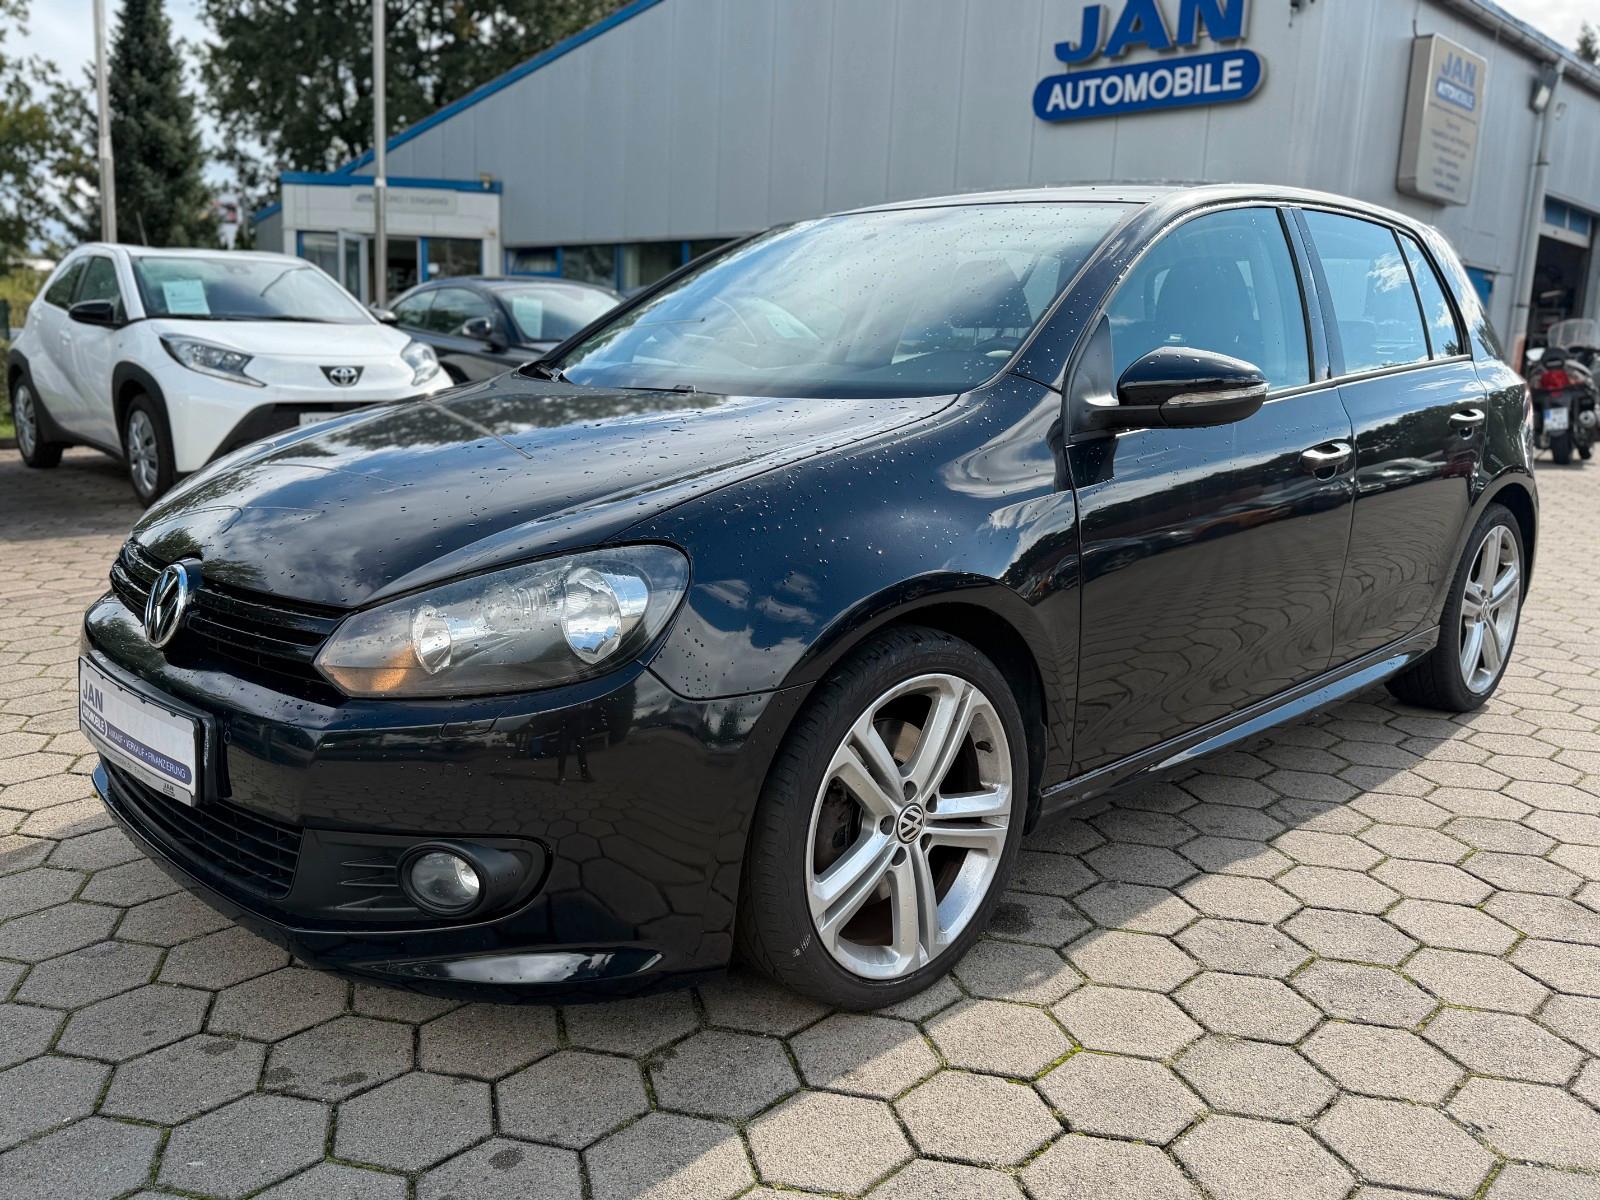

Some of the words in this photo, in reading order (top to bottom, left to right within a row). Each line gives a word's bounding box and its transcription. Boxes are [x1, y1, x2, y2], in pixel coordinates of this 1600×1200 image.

[1054, 0, 1248, 64] JAN
[1045, 58, 1245, 113] AUTOMOBILE
[1441, 51, 1477, 88] JAN
[83, 680, 103, 712] JAN
[126, 739, 145, 757] VERKAUF
[147, 752, 186, 779] FINANZIERUNG
